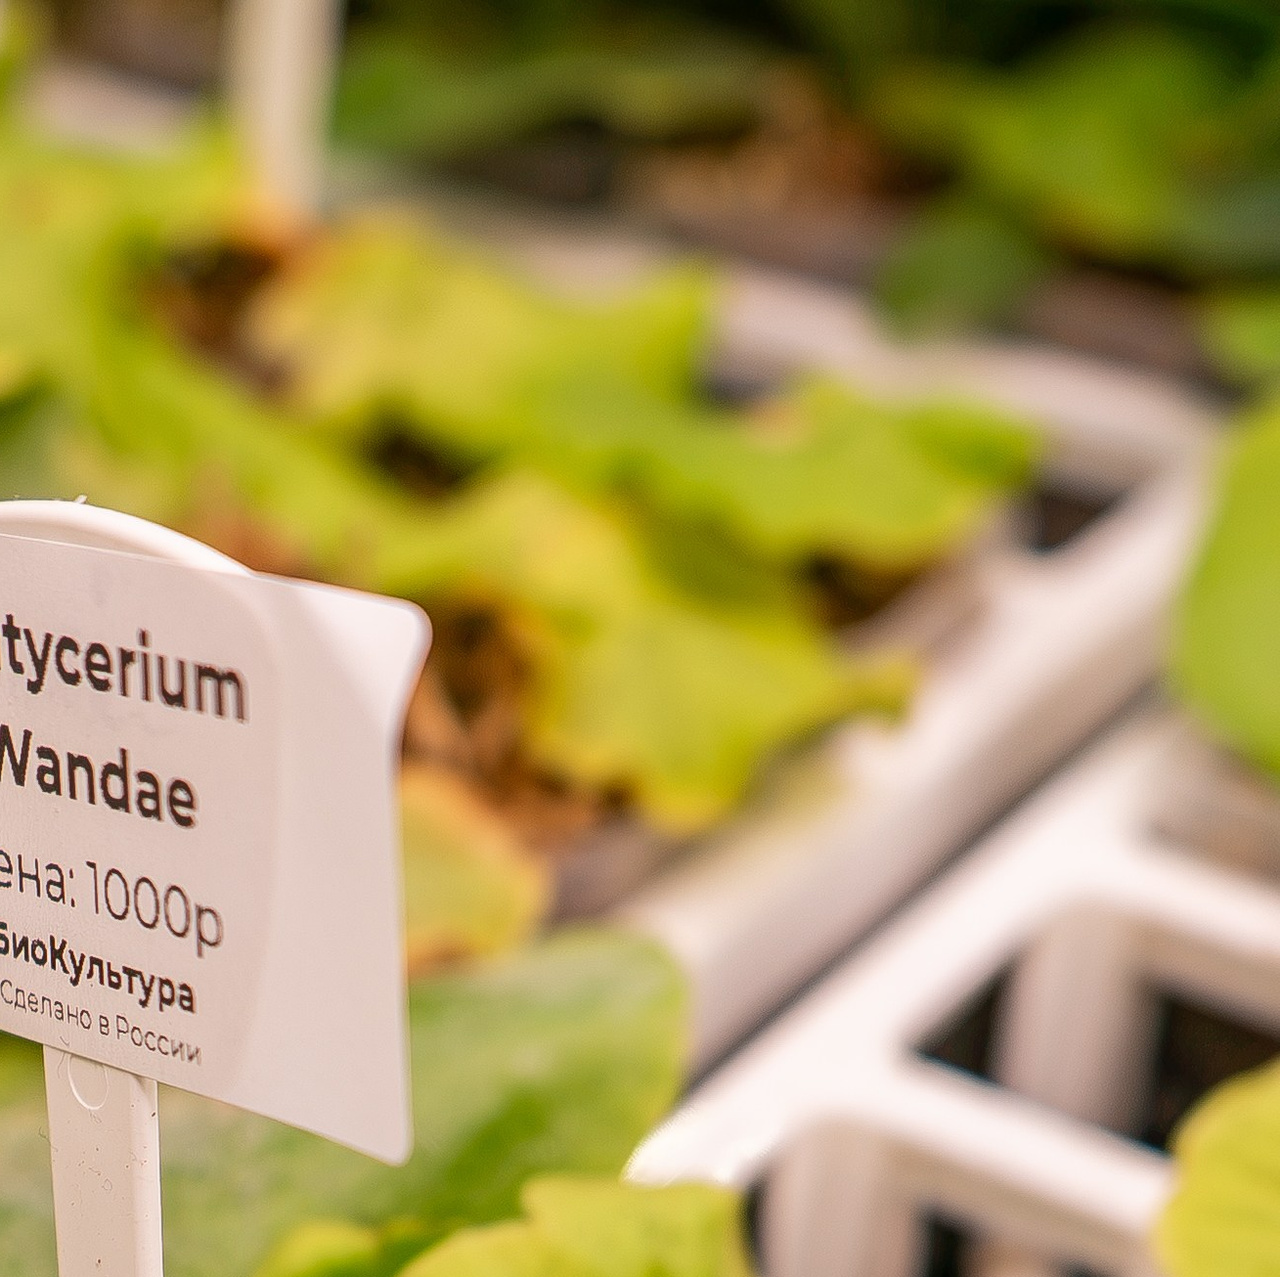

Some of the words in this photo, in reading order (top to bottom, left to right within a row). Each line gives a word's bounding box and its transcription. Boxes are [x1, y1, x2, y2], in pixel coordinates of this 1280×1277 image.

[0, 979, 92, 1032] Сделано
[98, 1015, 111, 1038] в
[116, 1015, 202, 1065] России
